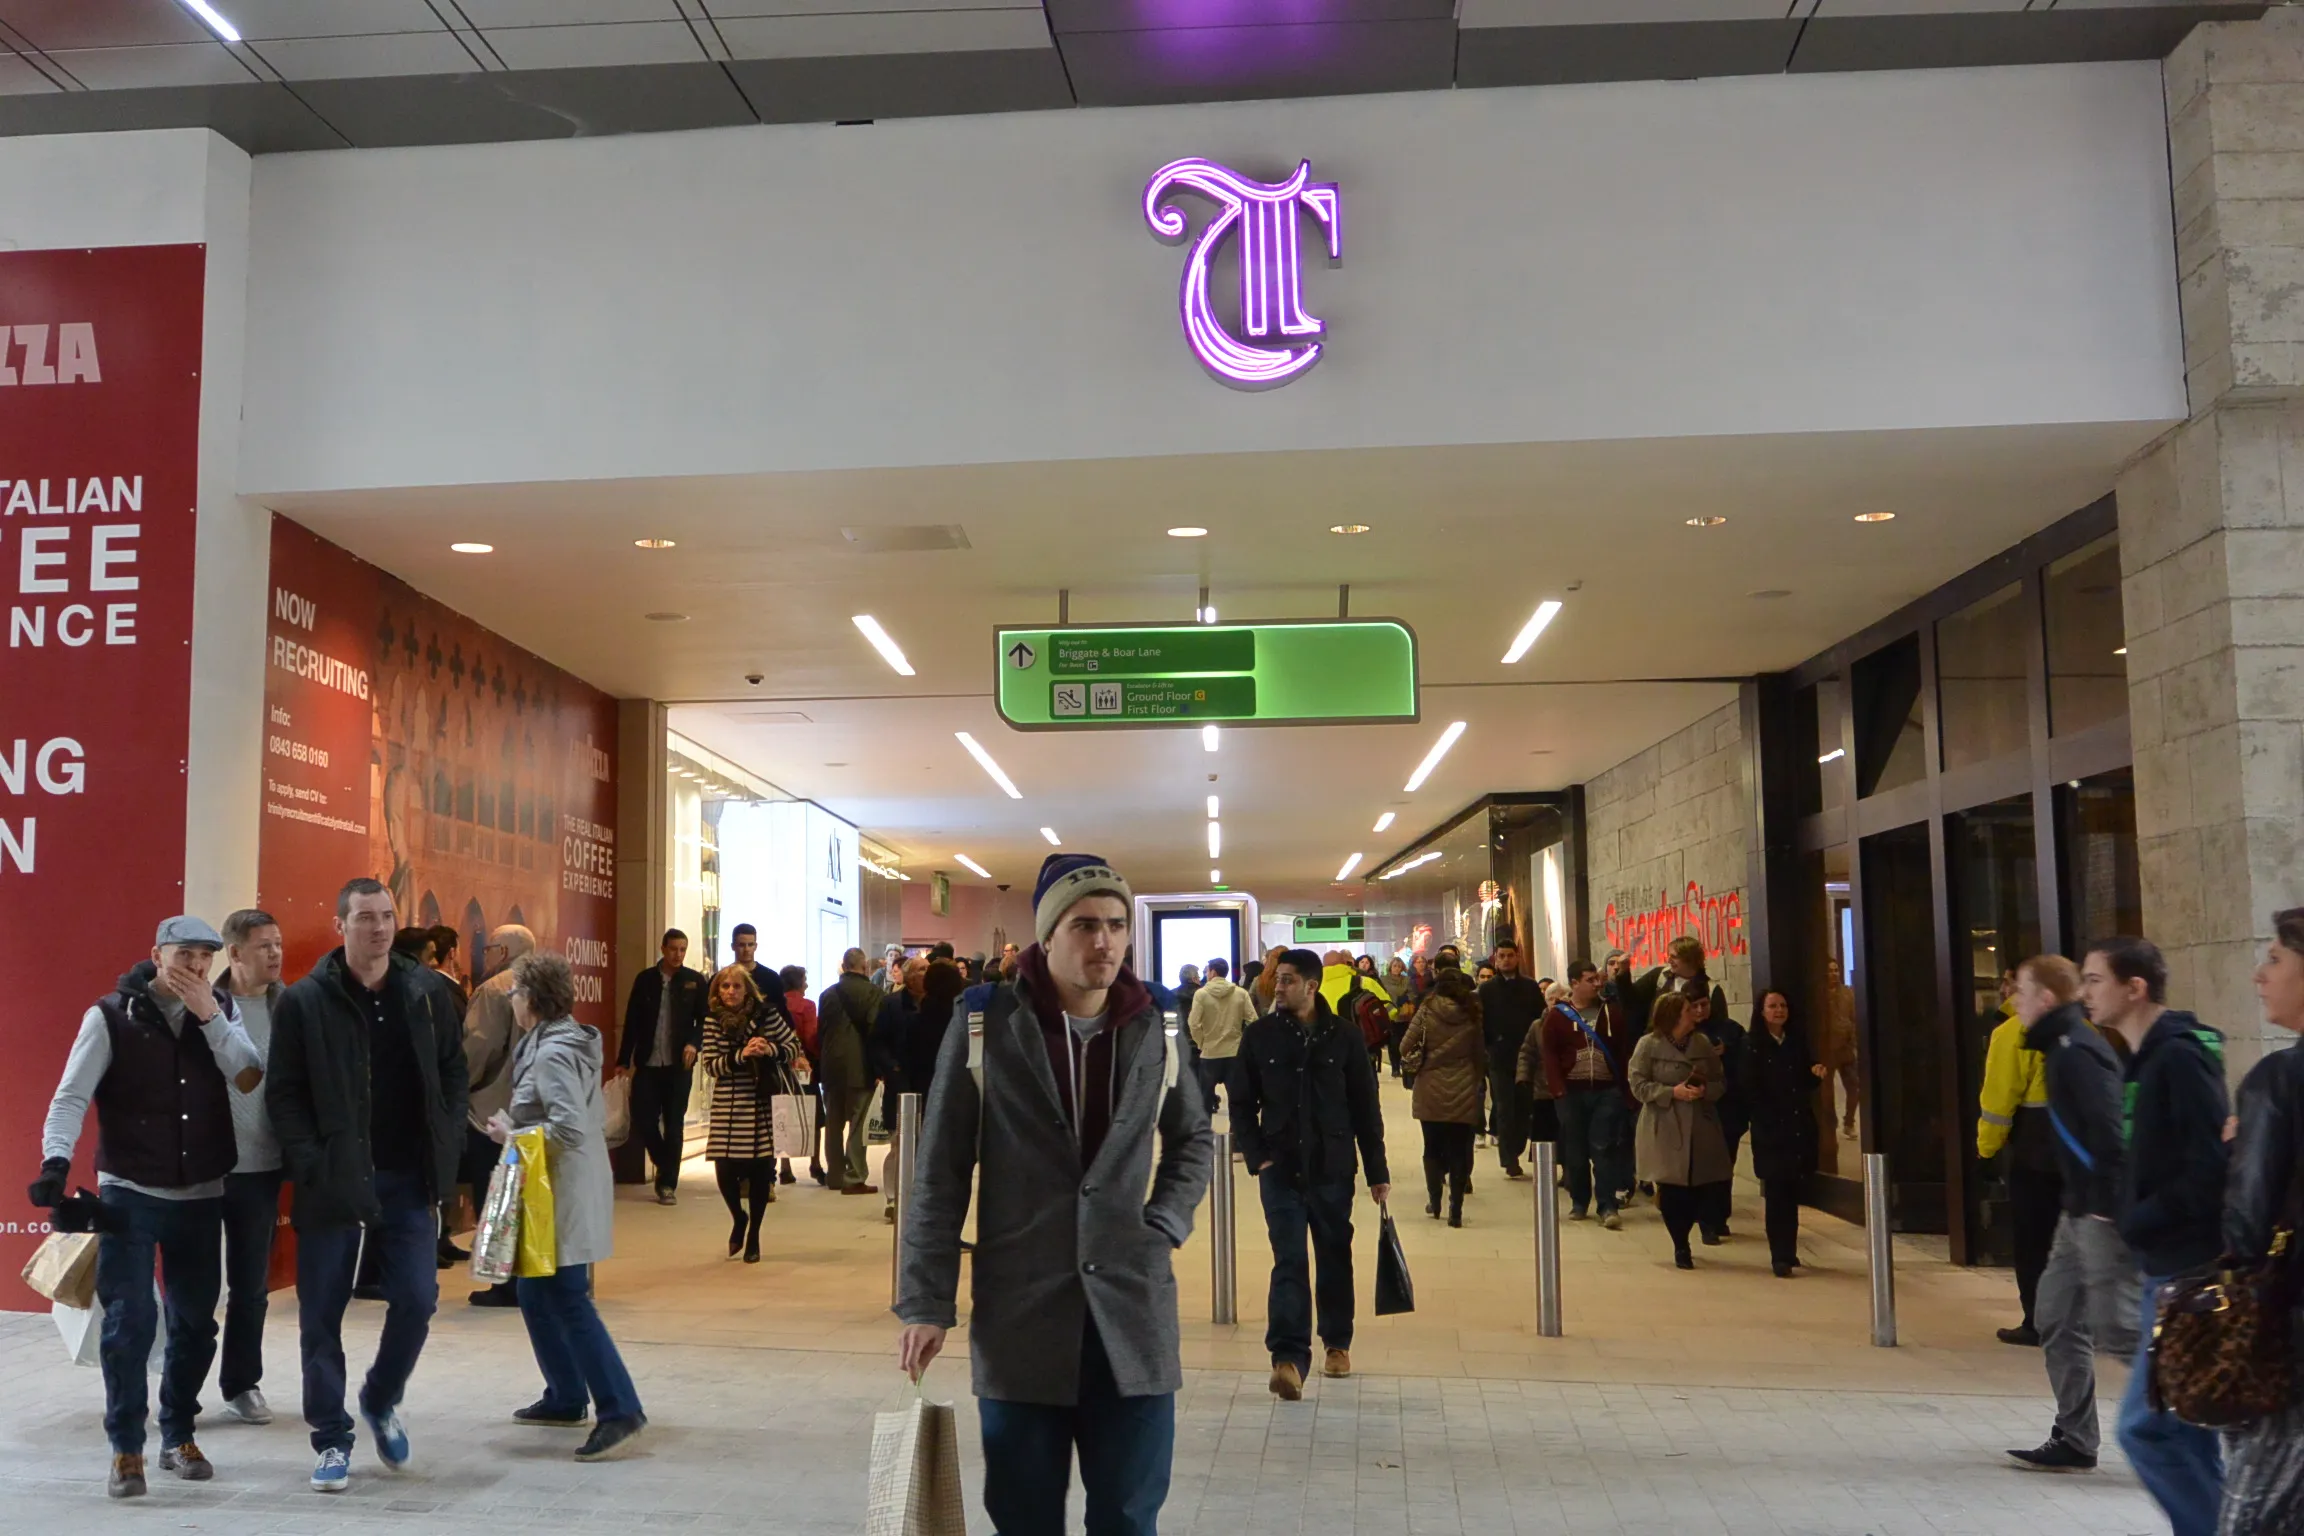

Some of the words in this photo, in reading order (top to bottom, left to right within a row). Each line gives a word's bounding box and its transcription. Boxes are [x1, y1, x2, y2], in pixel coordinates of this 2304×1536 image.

[0, 523, 141, 594] EE
[275, 586, 317, 632] NOW
[274, 635, 369, 701] RECRUITING
[1059, 648, 1100, 661] Briggate
[1102, 647, 1111, 658] &
[1113, 647, 1136, 657] Boar
[1138, 646, 1162, 657] Lane
[1126, 691, 1164, 702] Ground
[1166, 691, 1192, 701] Floor
[1127, 704, 1149, 715] First
[1151, 703, 1177, 714] Floor
[270, 703, 291, 727] Info:
[269, 735, 291, 758] 0843
[308, 746, 329, 769] 0160
[564, 813, 576, 833] THE
[563, 835, 613, 877] COFFEE
[562, 869, 613, 899] EXPERIENCE
[565, 936, 609, 969] COMING
[573, 974, 602, 1003] SOON
